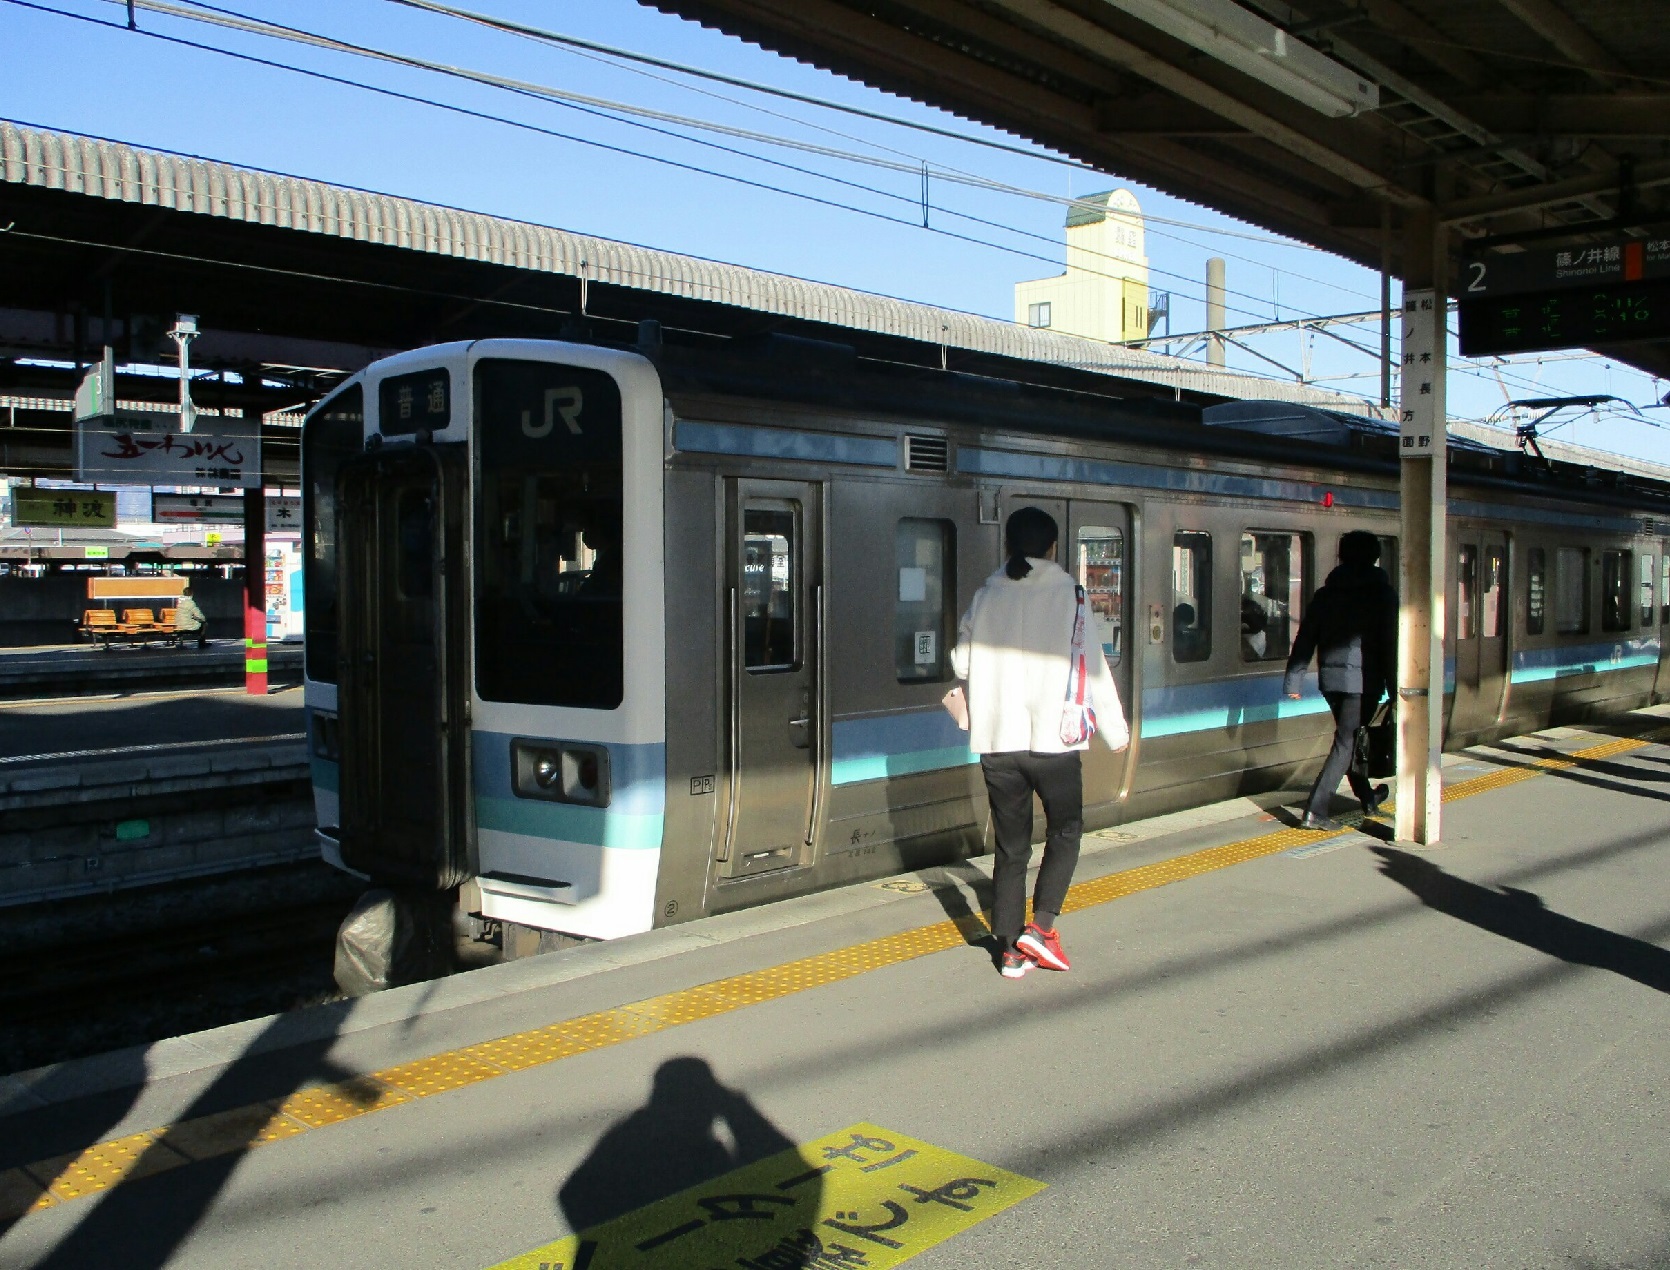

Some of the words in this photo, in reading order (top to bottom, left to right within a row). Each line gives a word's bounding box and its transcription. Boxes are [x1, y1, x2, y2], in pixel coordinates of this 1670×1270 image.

[1556, 246, 1620, 268] 篠ノ井線
[1556, 266, 1597, 279] Shinonoi
[1600, 263, 1620, 274] Line
[1467, 262, 1487, 292] 2
[398, 380, 445, 418] 普通
[521, 386, 583, 438] JR
